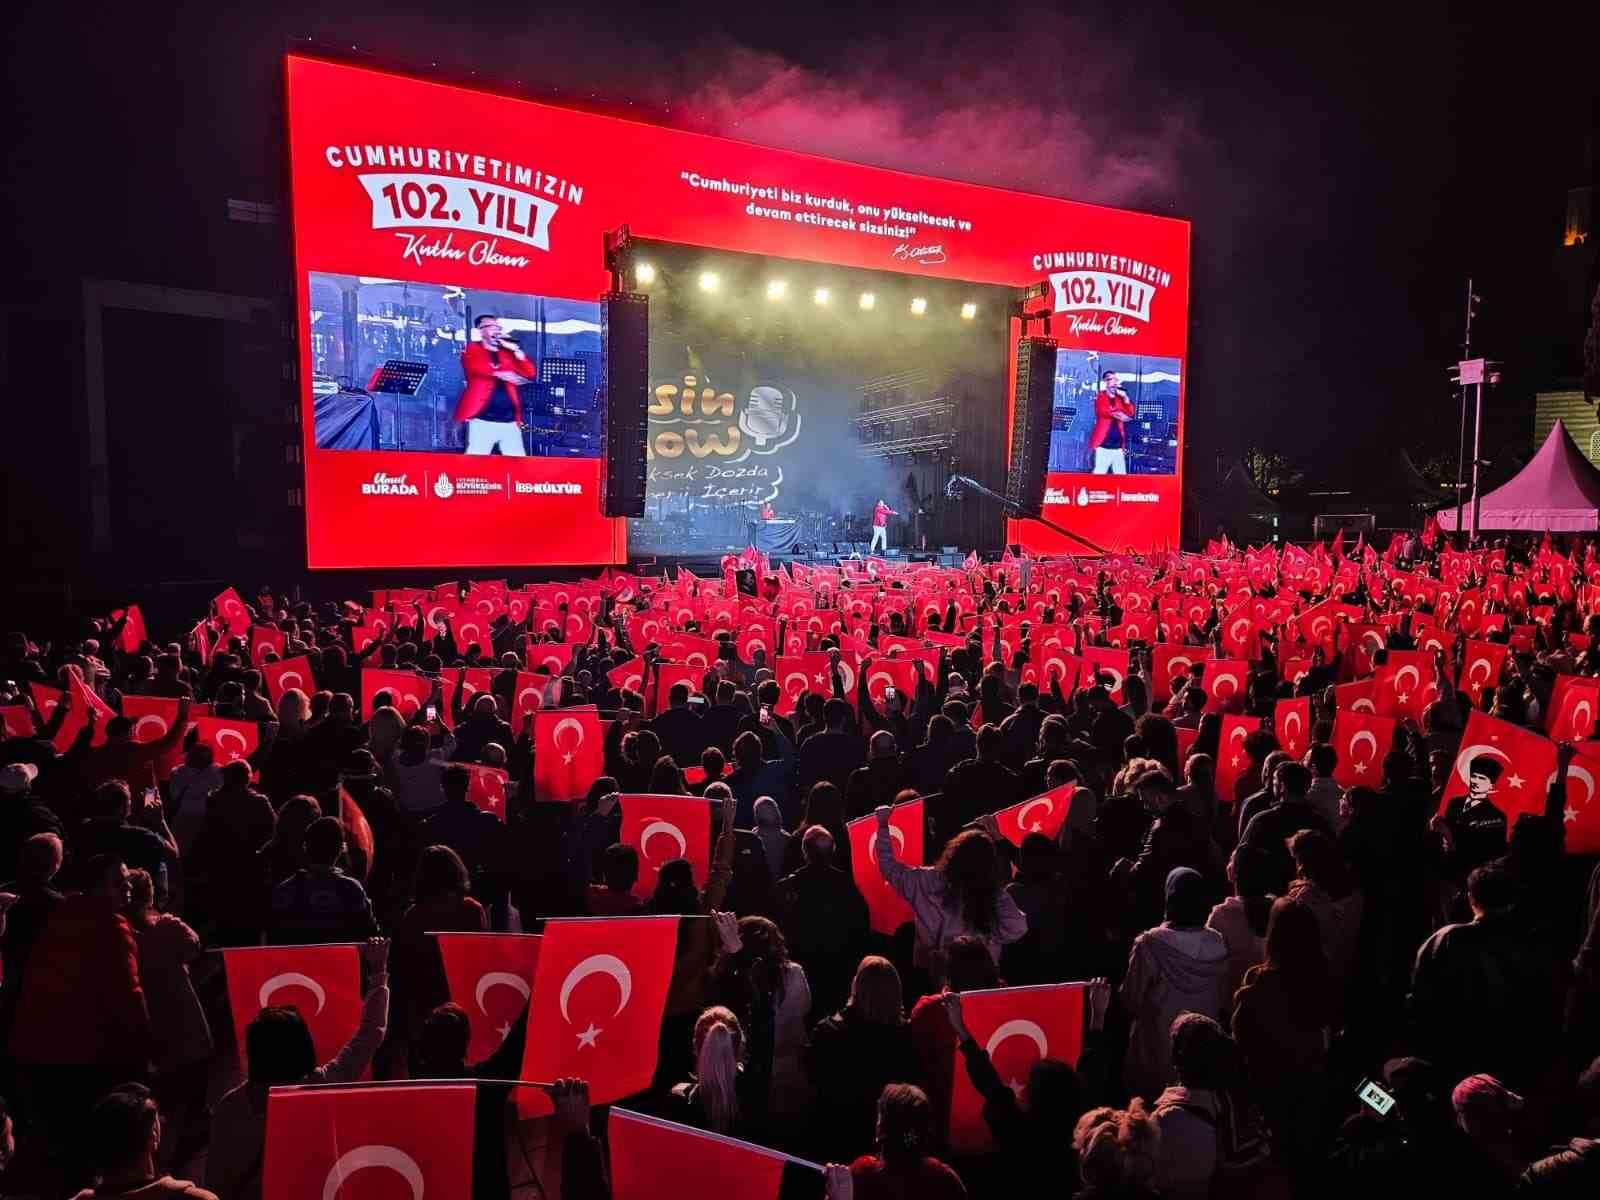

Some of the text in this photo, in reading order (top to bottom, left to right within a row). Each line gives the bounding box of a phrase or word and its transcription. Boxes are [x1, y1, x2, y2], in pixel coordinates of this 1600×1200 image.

[383, 182, 539, 237] 102. YILI
[745, 203, 791, 220] devam
[795, 211, 856, 231] ettirecek
[781, 188, 802, 204] biz
[805, 192, 854, 214] kurduk,
[857, 204, 880, 217] onu
[883, 207, 956, 228] yükseltecek
[959, 219, 972, 231] ve
[395, 232, 530, 268] Kutlu Olsun
[1061, 277, 1145, 313] 102. YILI
[647, 426, 740, 459] ow
[704, 464, 768, 479] Dozda
[361, 483, 419, 495] BURADA
